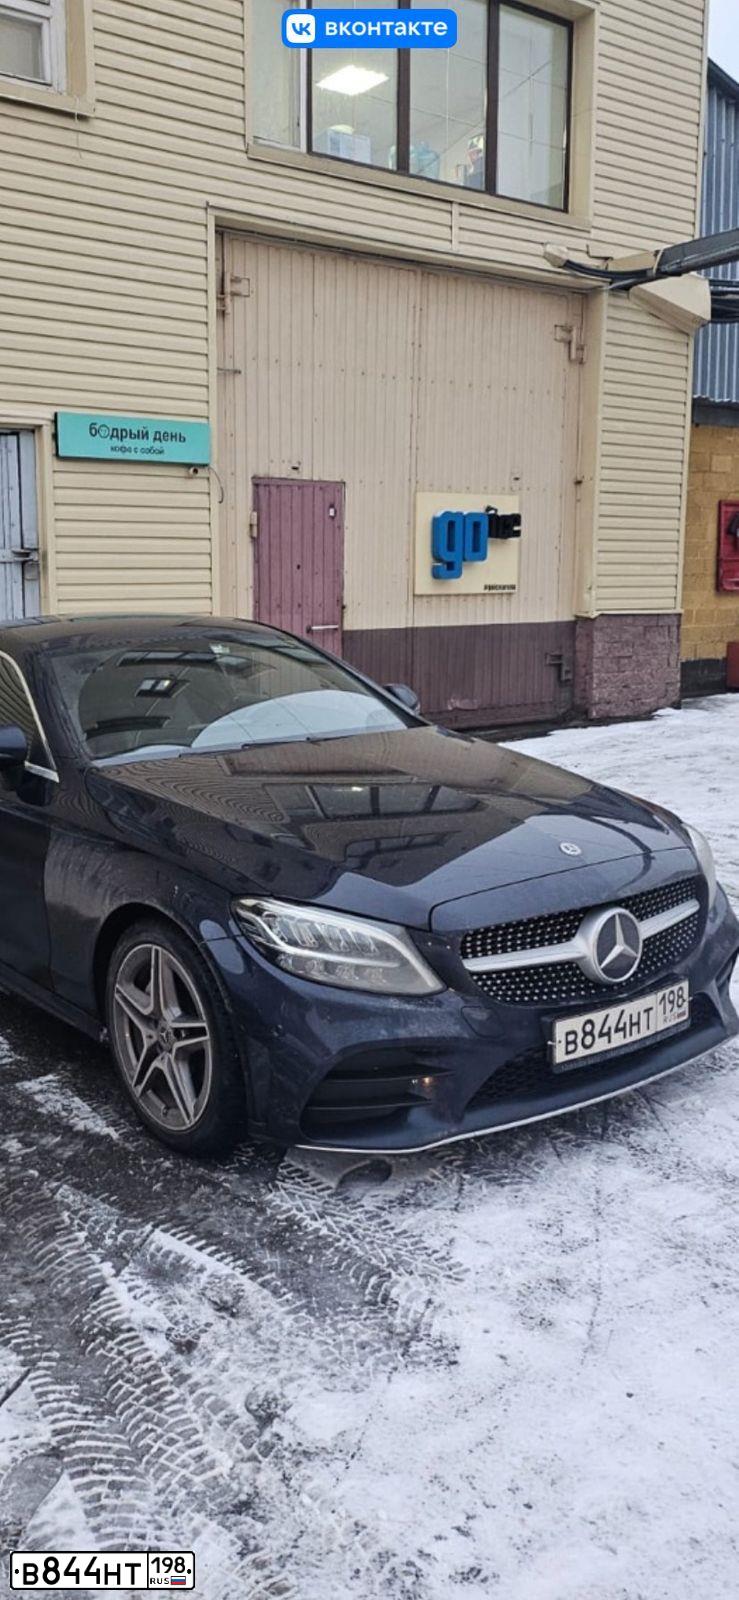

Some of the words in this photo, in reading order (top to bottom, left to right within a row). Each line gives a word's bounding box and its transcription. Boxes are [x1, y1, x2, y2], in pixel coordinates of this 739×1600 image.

[153, 431, 186, 443] день
[110, 446, 132, 454] кофе
[140, 447, 164, 455] собой
[565, 1007, 653, 1055] В844НТ
[659, 986, 684, 1015] 198
